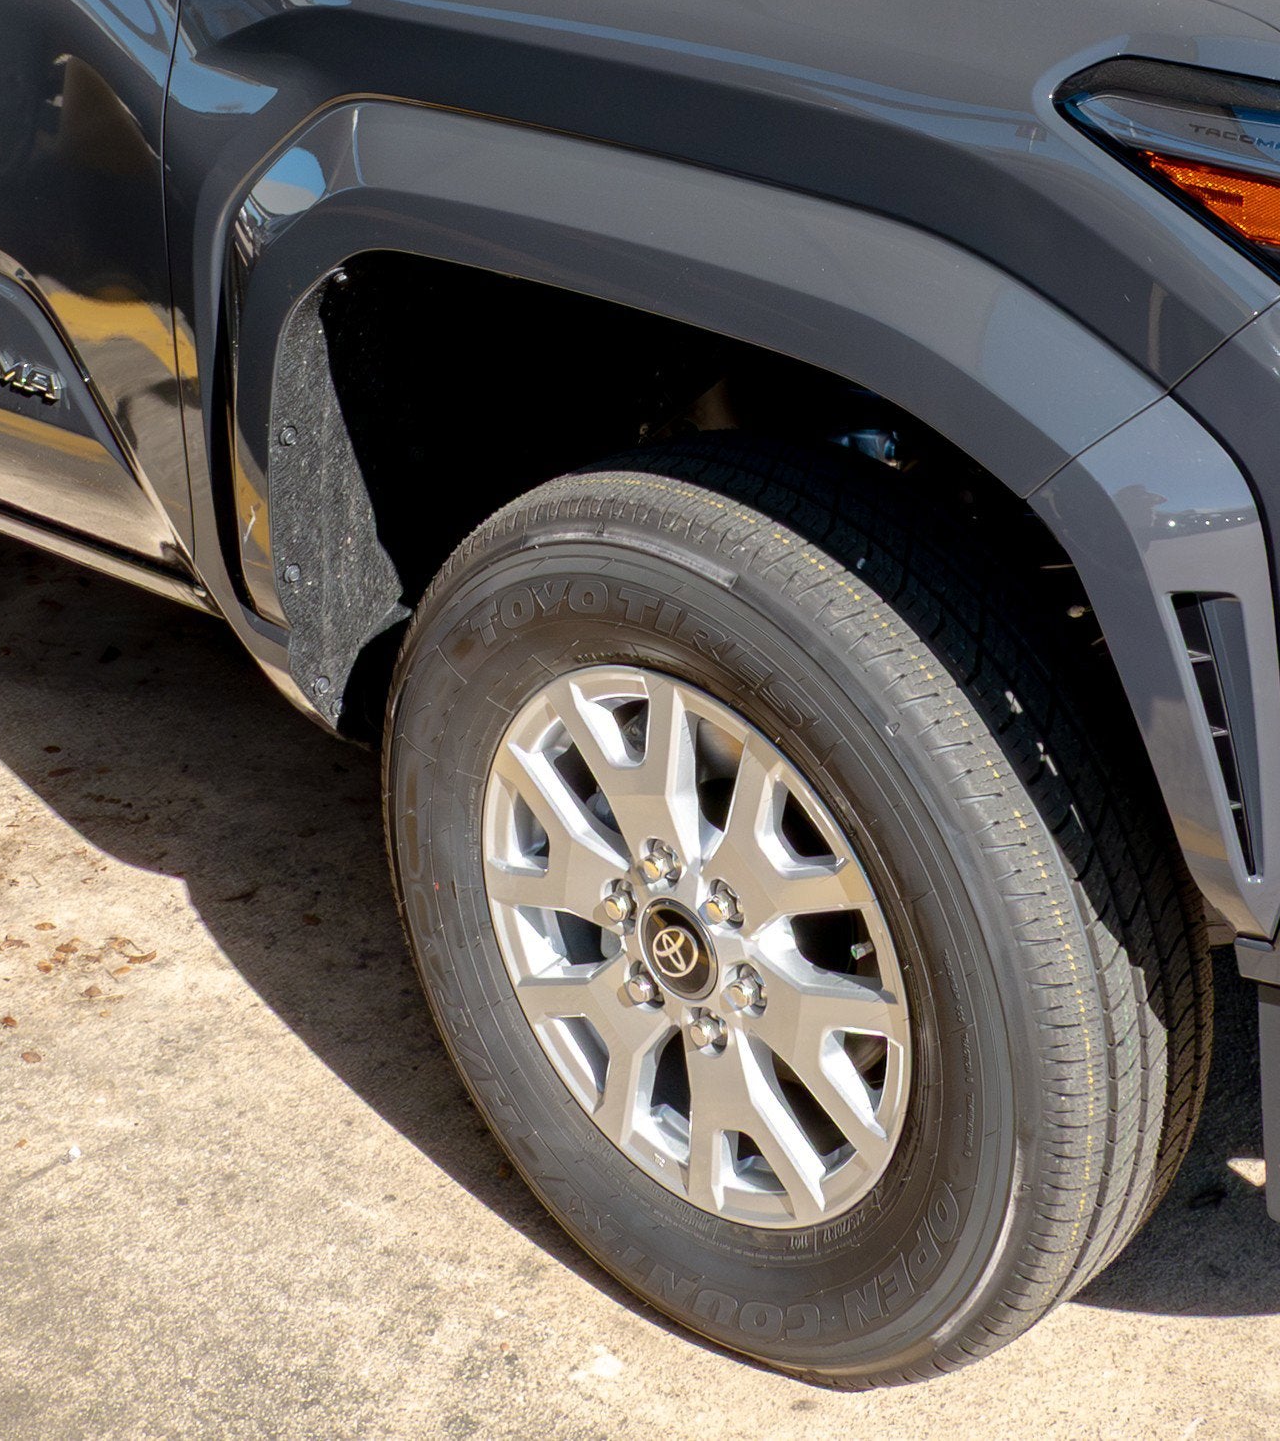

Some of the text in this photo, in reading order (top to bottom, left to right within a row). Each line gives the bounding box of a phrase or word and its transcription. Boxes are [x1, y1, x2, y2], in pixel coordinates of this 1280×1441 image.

[470, 579, 822, 732] TOYO TIRES
[535, 1174, 821, 1343] COUNTRY
[842, 1177, 961, 1336] OPEN
